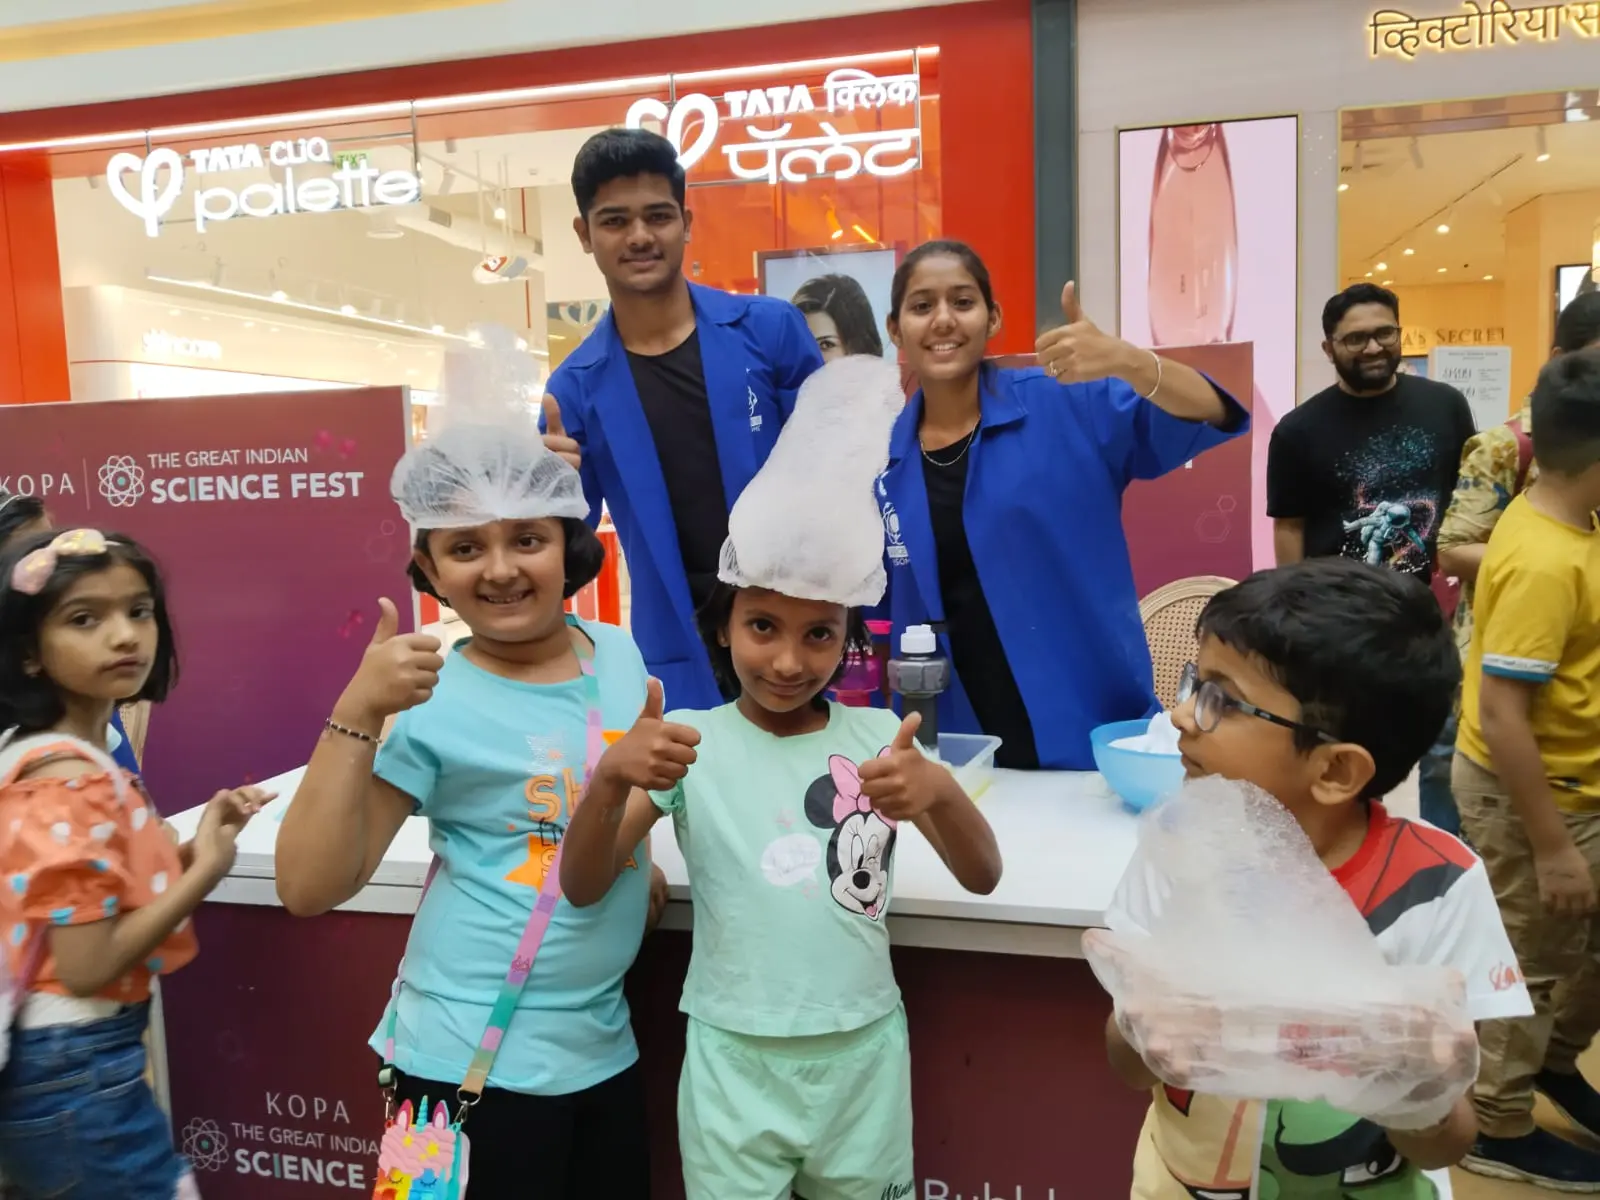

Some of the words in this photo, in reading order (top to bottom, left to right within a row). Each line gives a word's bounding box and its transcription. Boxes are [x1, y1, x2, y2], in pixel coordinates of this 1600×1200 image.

[724, 84, 815, 118] TATA
[824, 68, 920, 113] क्लिक
[190, 143, 265, 173] TATA
[194, 158, 420, 233] palette
[147, 453, 181, 469] THE
[185, 449, 241, 468] GREAT
[246, 447, 308, 464] INDIAN
[0, 472, 76, 496] KOPA
[150, 473, 281, 504] SCIENCE
[290, 471, 364, 499] FEST
[265, 1091, 351, 1124] KOPA
[231, 1122, 265, 1142] THE
[268, 1126, 326, 1150] GREAT
[329, 1135, 381, 1155] INDIA
[234, 1148, 367, 1190] SCIENCE
